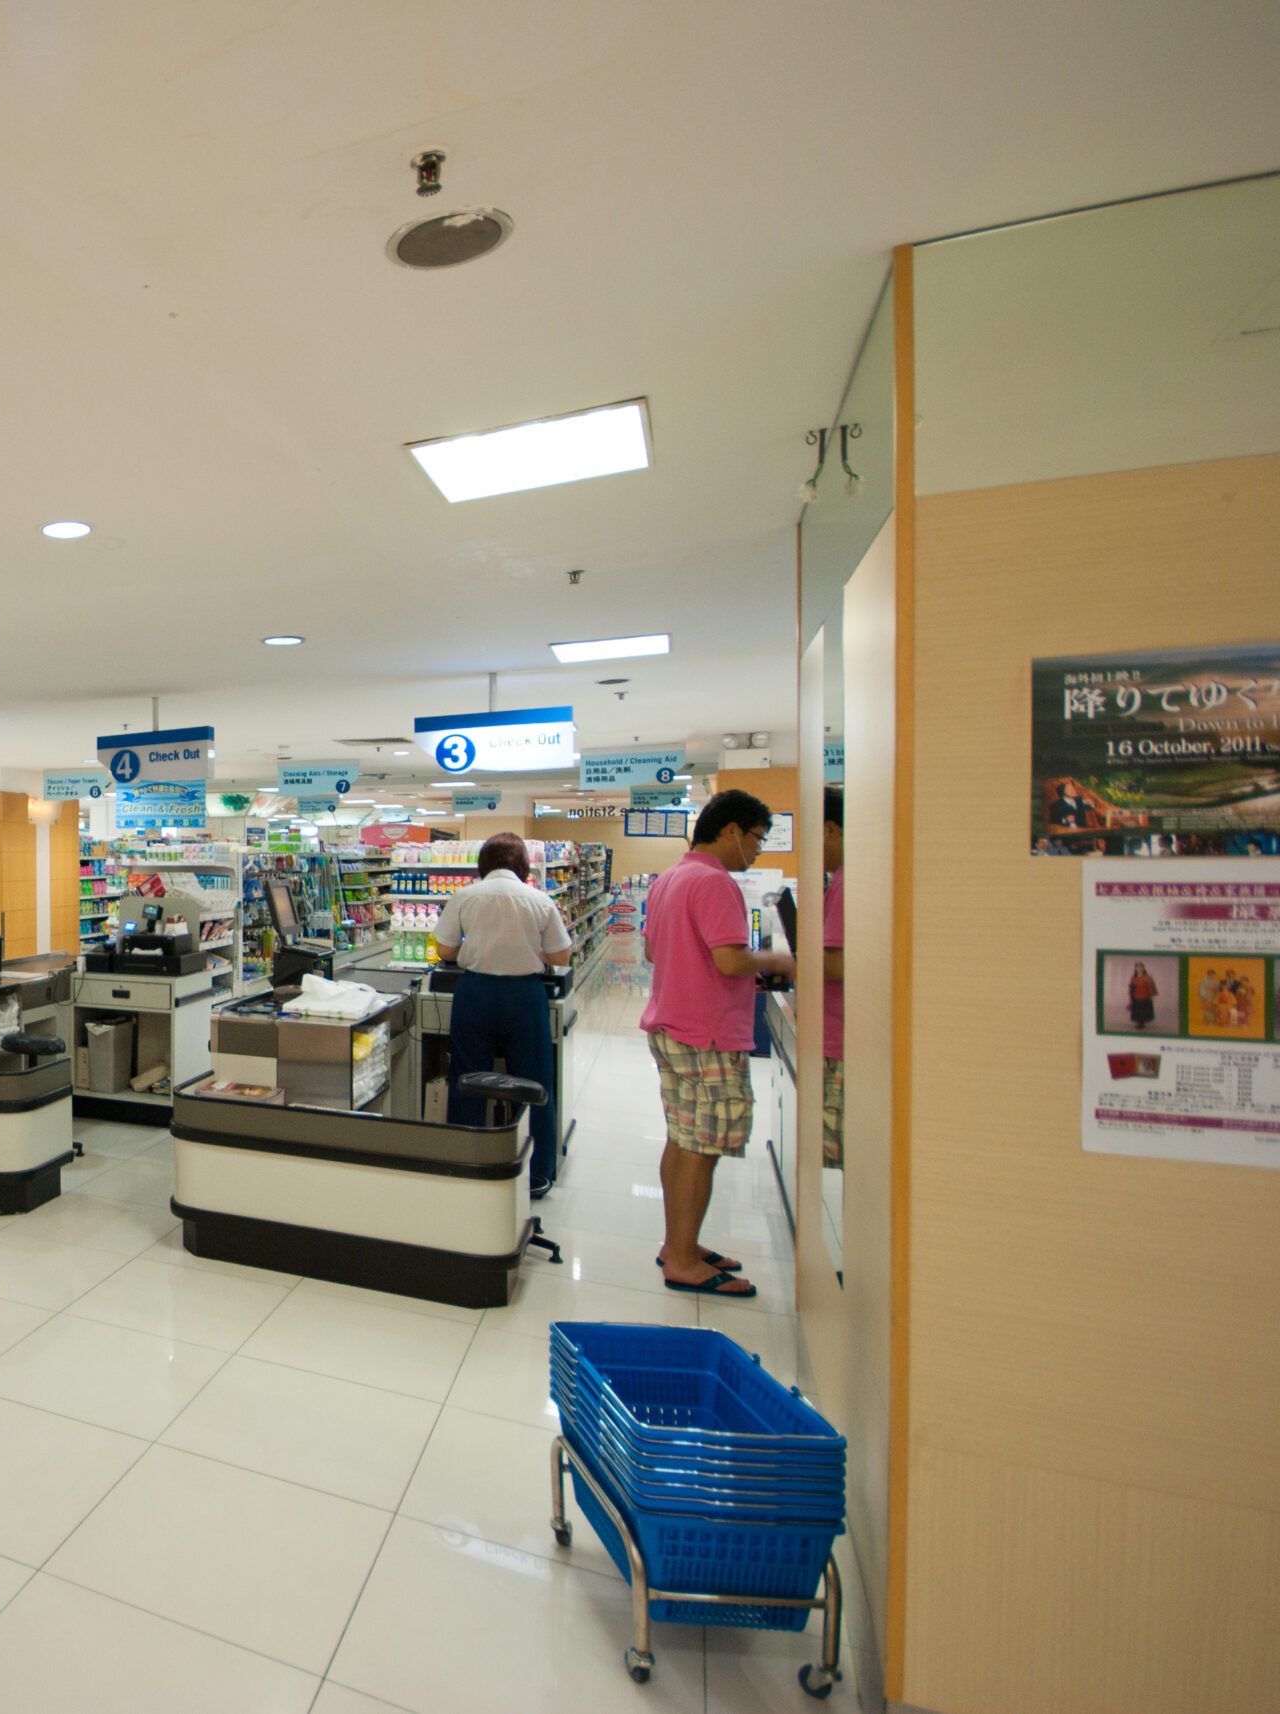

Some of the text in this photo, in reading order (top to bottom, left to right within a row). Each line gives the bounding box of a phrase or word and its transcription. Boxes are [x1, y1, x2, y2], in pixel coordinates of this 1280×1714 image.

[1064, 679, 1280, 720] 降りてゆく
[1179, 718, 1240, 733] Down
[1246, 717, 1265, 731] to
[489, 731, 561, 748] Check Out
[1106, 740, 1133, 756] 16
[1138, 737, 1215, 757] October,
[1220, 735, 1260, 752] 2011
[148, 748, 200, 762] Check Out
[443, 735, 468, 769] 3
[116, 752, 132, 779] 4
[585, 758, 625, 767] Household
[630, 757, 662, 765] Cleaning
[665, 755, 677, 763] Aid
[661, 770, 670, 782] 8
[122, 802, 201, 814] Clean & Fresh
